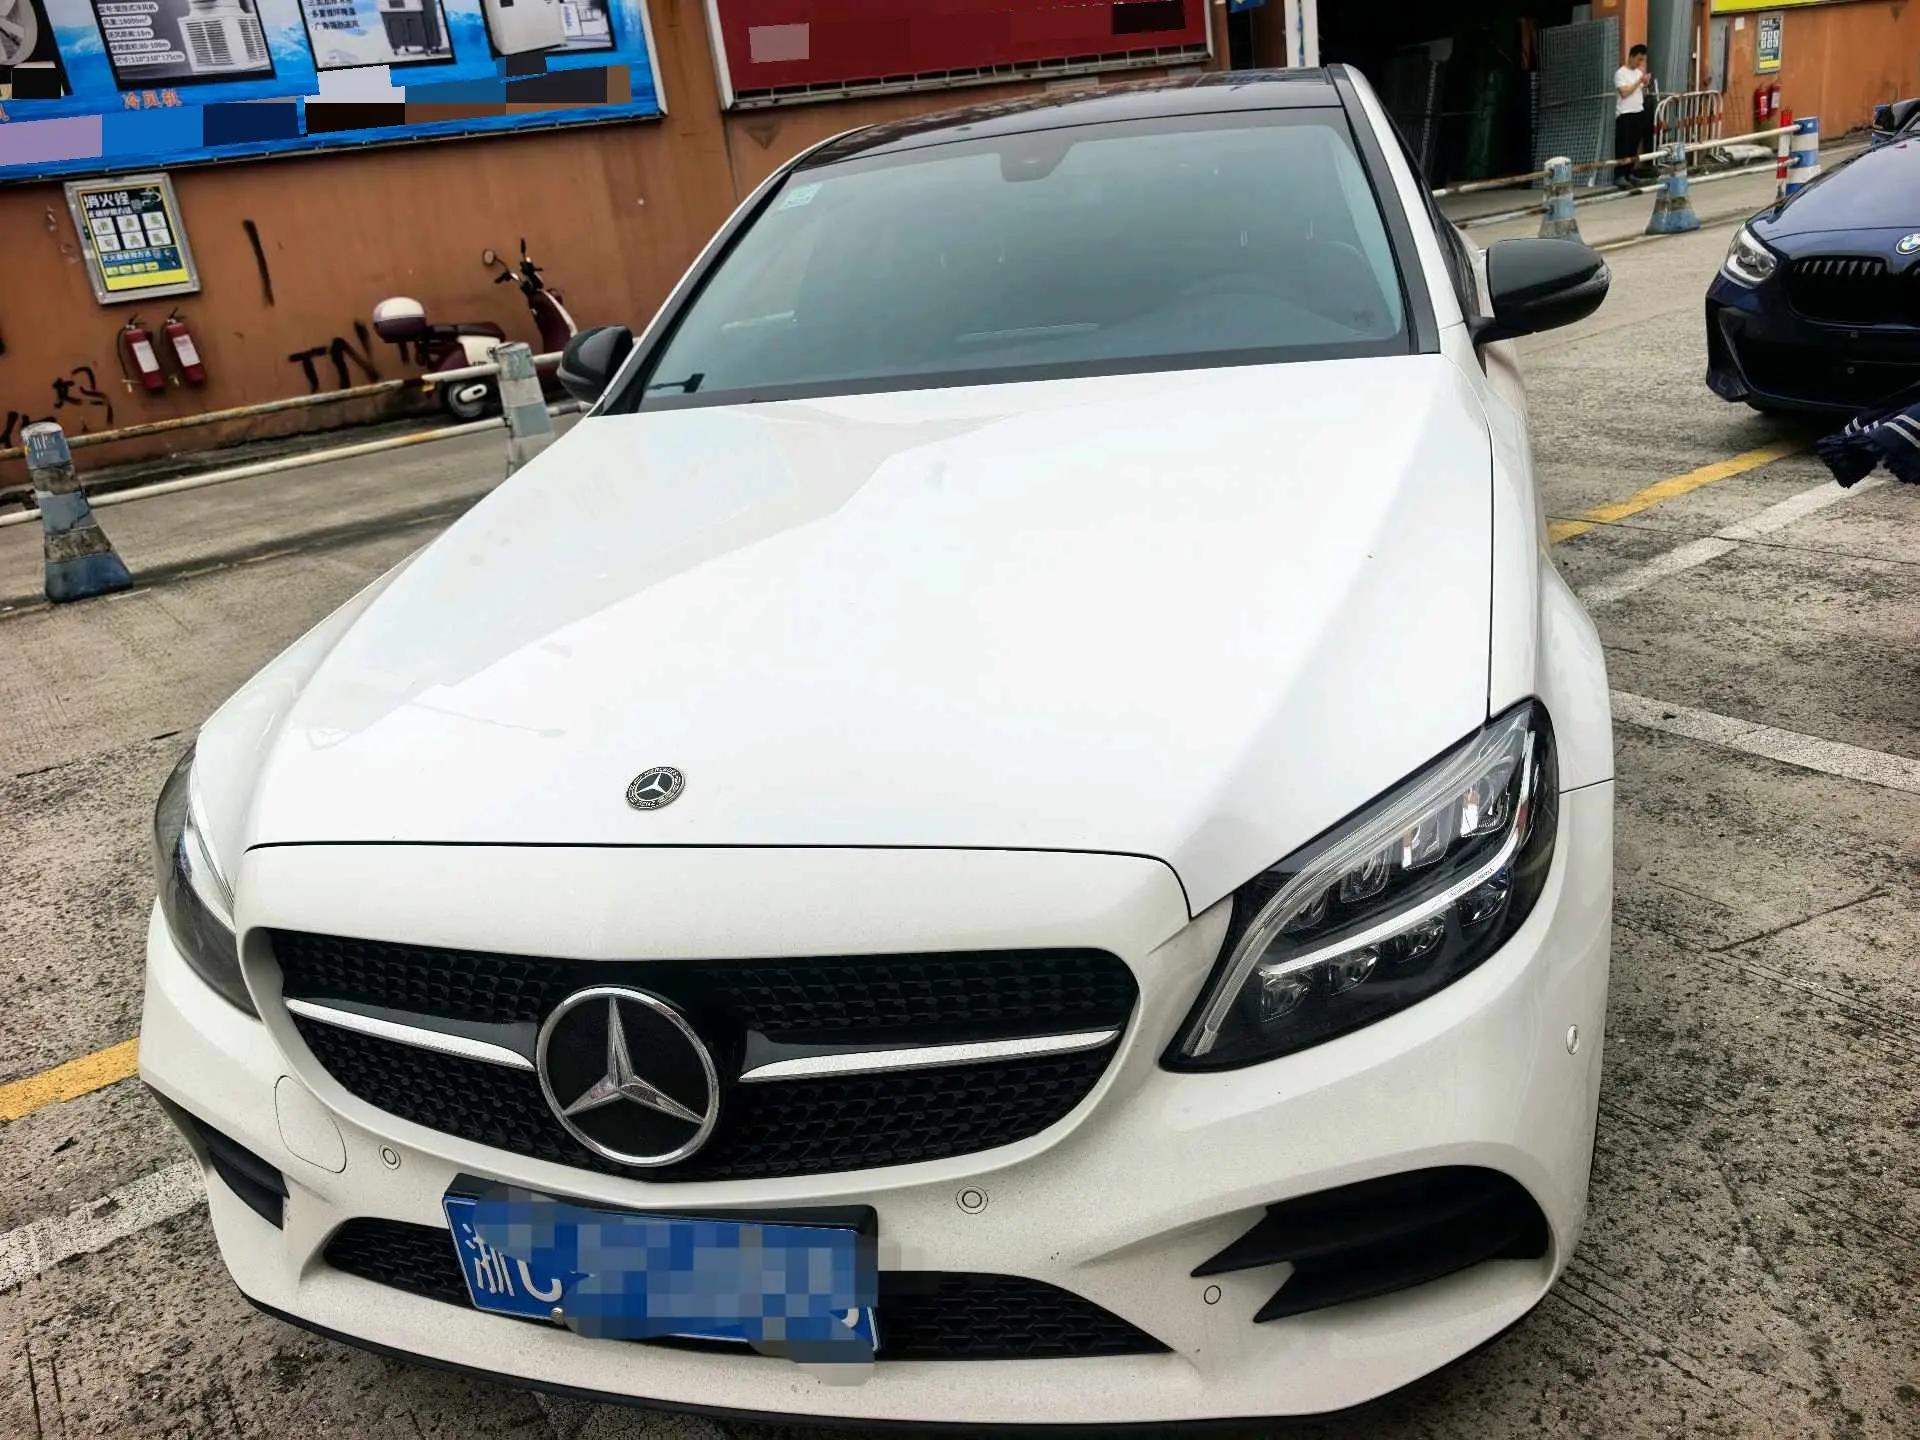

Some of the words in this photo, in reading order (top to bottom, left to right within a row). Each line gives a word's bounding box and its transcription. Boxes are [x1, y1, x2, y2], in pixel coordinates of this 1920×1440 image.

[122, 88, 184, 111] 冷风机
[85, 192, 130, 208] 消火栓
